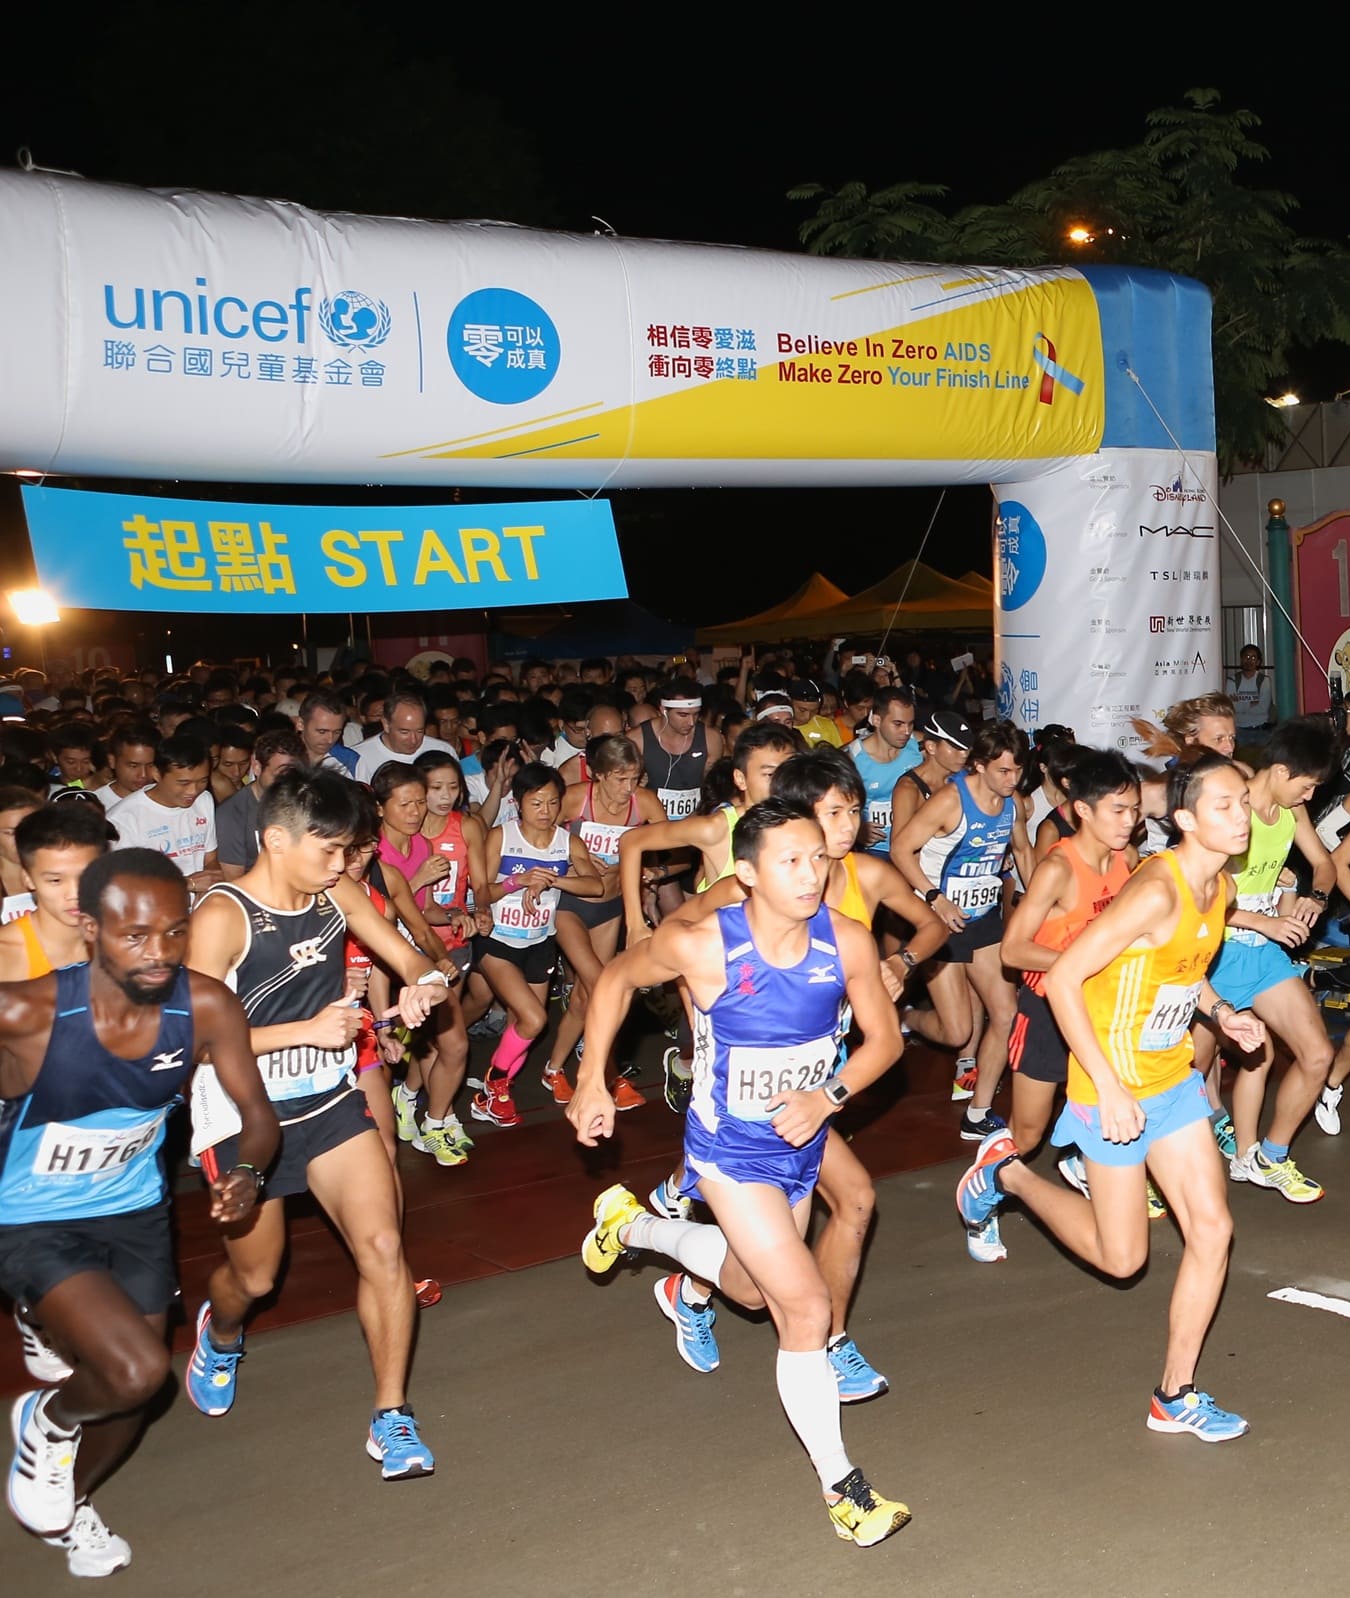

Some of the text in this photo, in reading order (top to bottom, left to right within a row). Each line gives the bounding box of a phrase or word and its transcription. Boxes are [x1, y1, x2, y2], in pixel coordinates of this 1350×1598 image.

[103, 277, 312, 344] unicef
[462, 323, 505, 370] 零
[647, 324, 757, 352] 相信零愛滋
[777, 332, 992, 363] Believe In Zero AIDS
[103, 339, 387, 387] 聯合國兒童基金會
[506, 347, 548, 370] 成真
[648, 354, 757, 381] 衝向零終點
[778, 362, 1030, 390] Make Zero Your Finish Line
[121, 513, 546, 595] 起點 START
[1149, 571, 1178, 581] TSL
[739, 1059, 826, 1101] H3628
